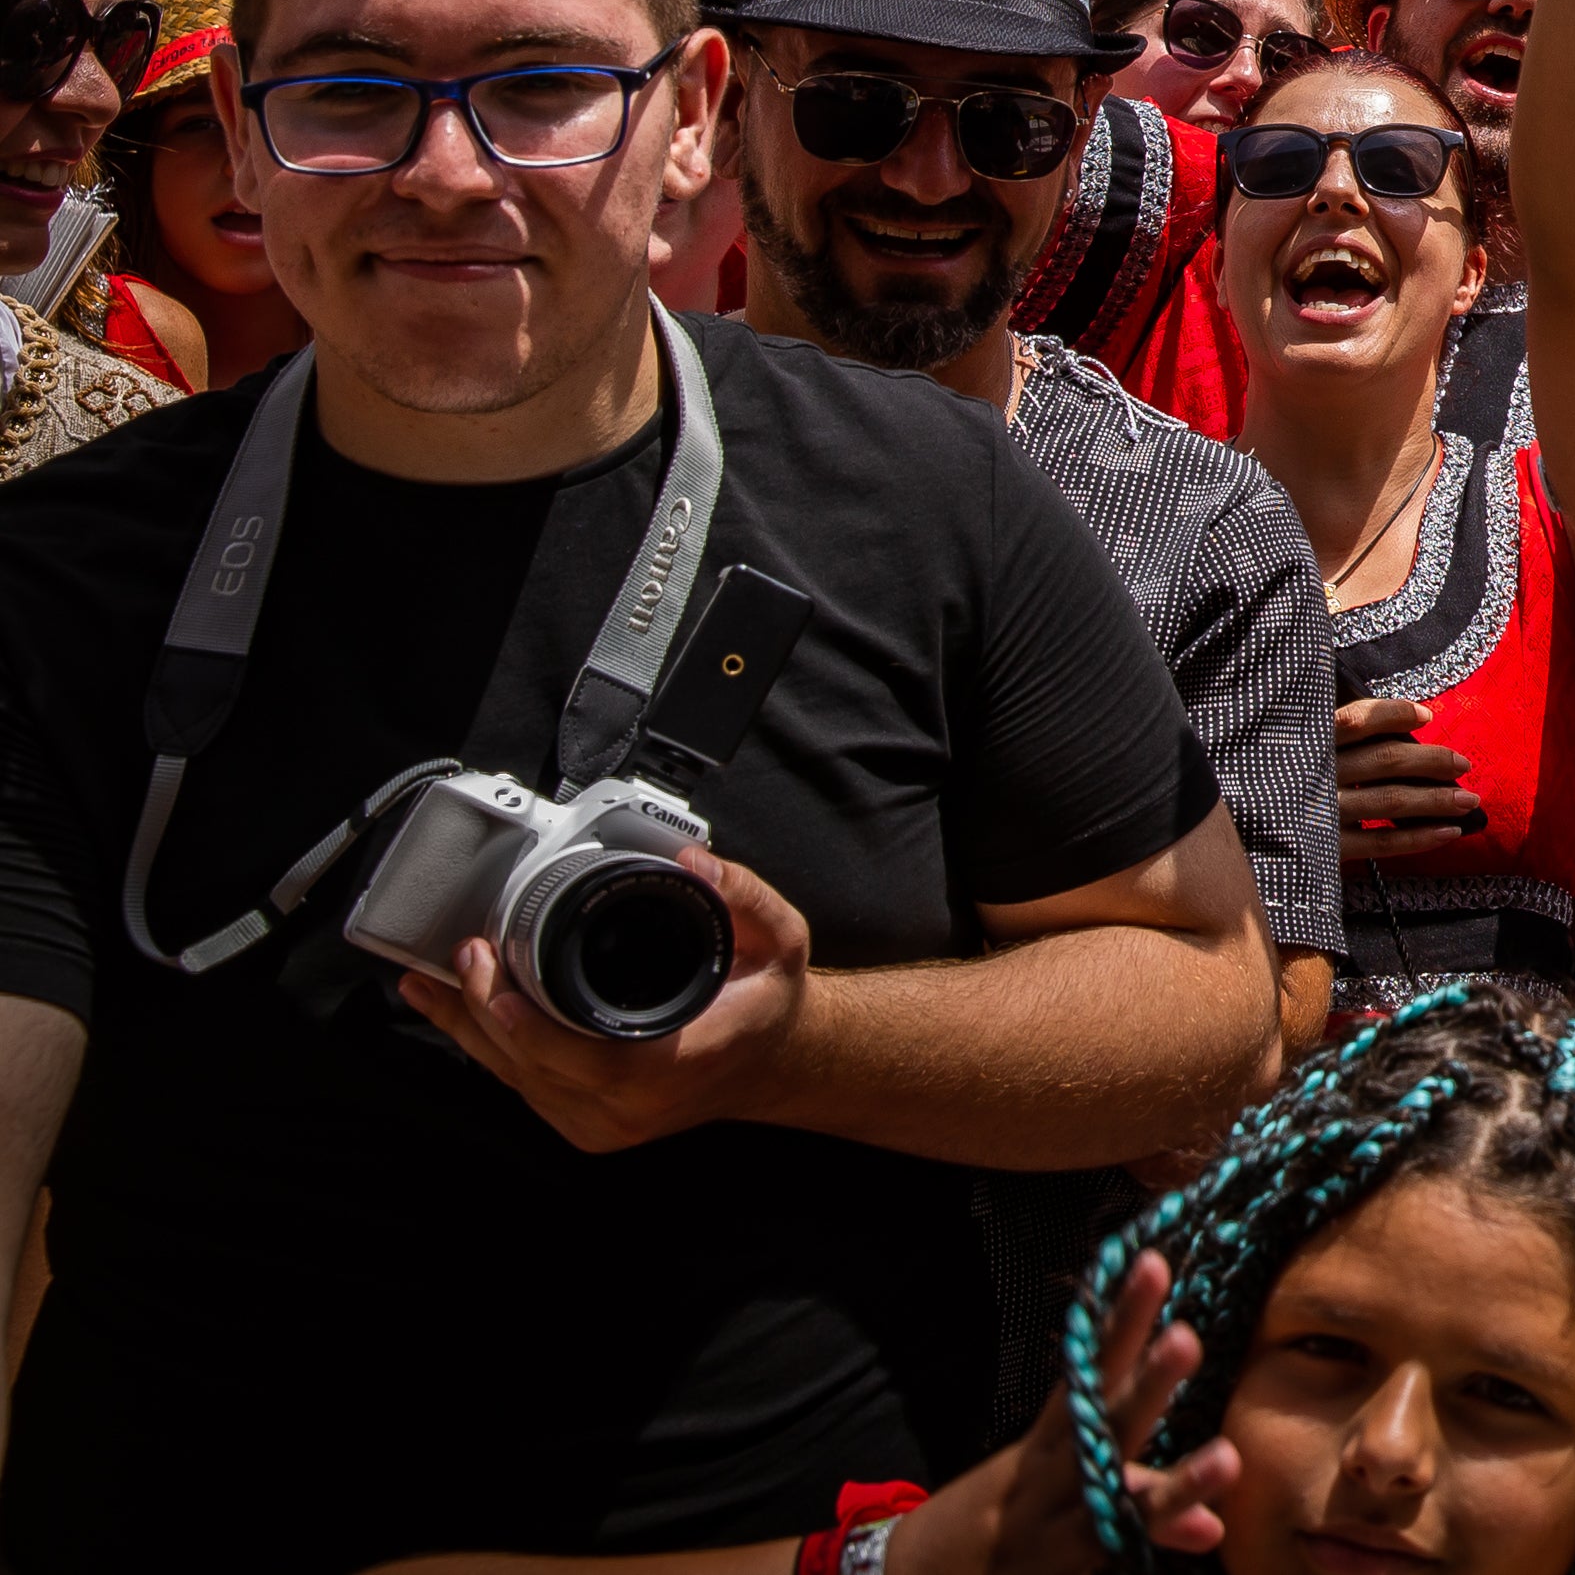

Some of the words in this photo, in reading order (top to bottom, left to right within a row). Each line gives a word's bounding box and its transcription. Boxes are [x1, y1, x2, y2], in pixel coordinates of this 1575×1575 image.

[210, 514, 265, 597] EOS
[626, 496, 692, 634] Canon
[639, 800, 702, 838] Canon
